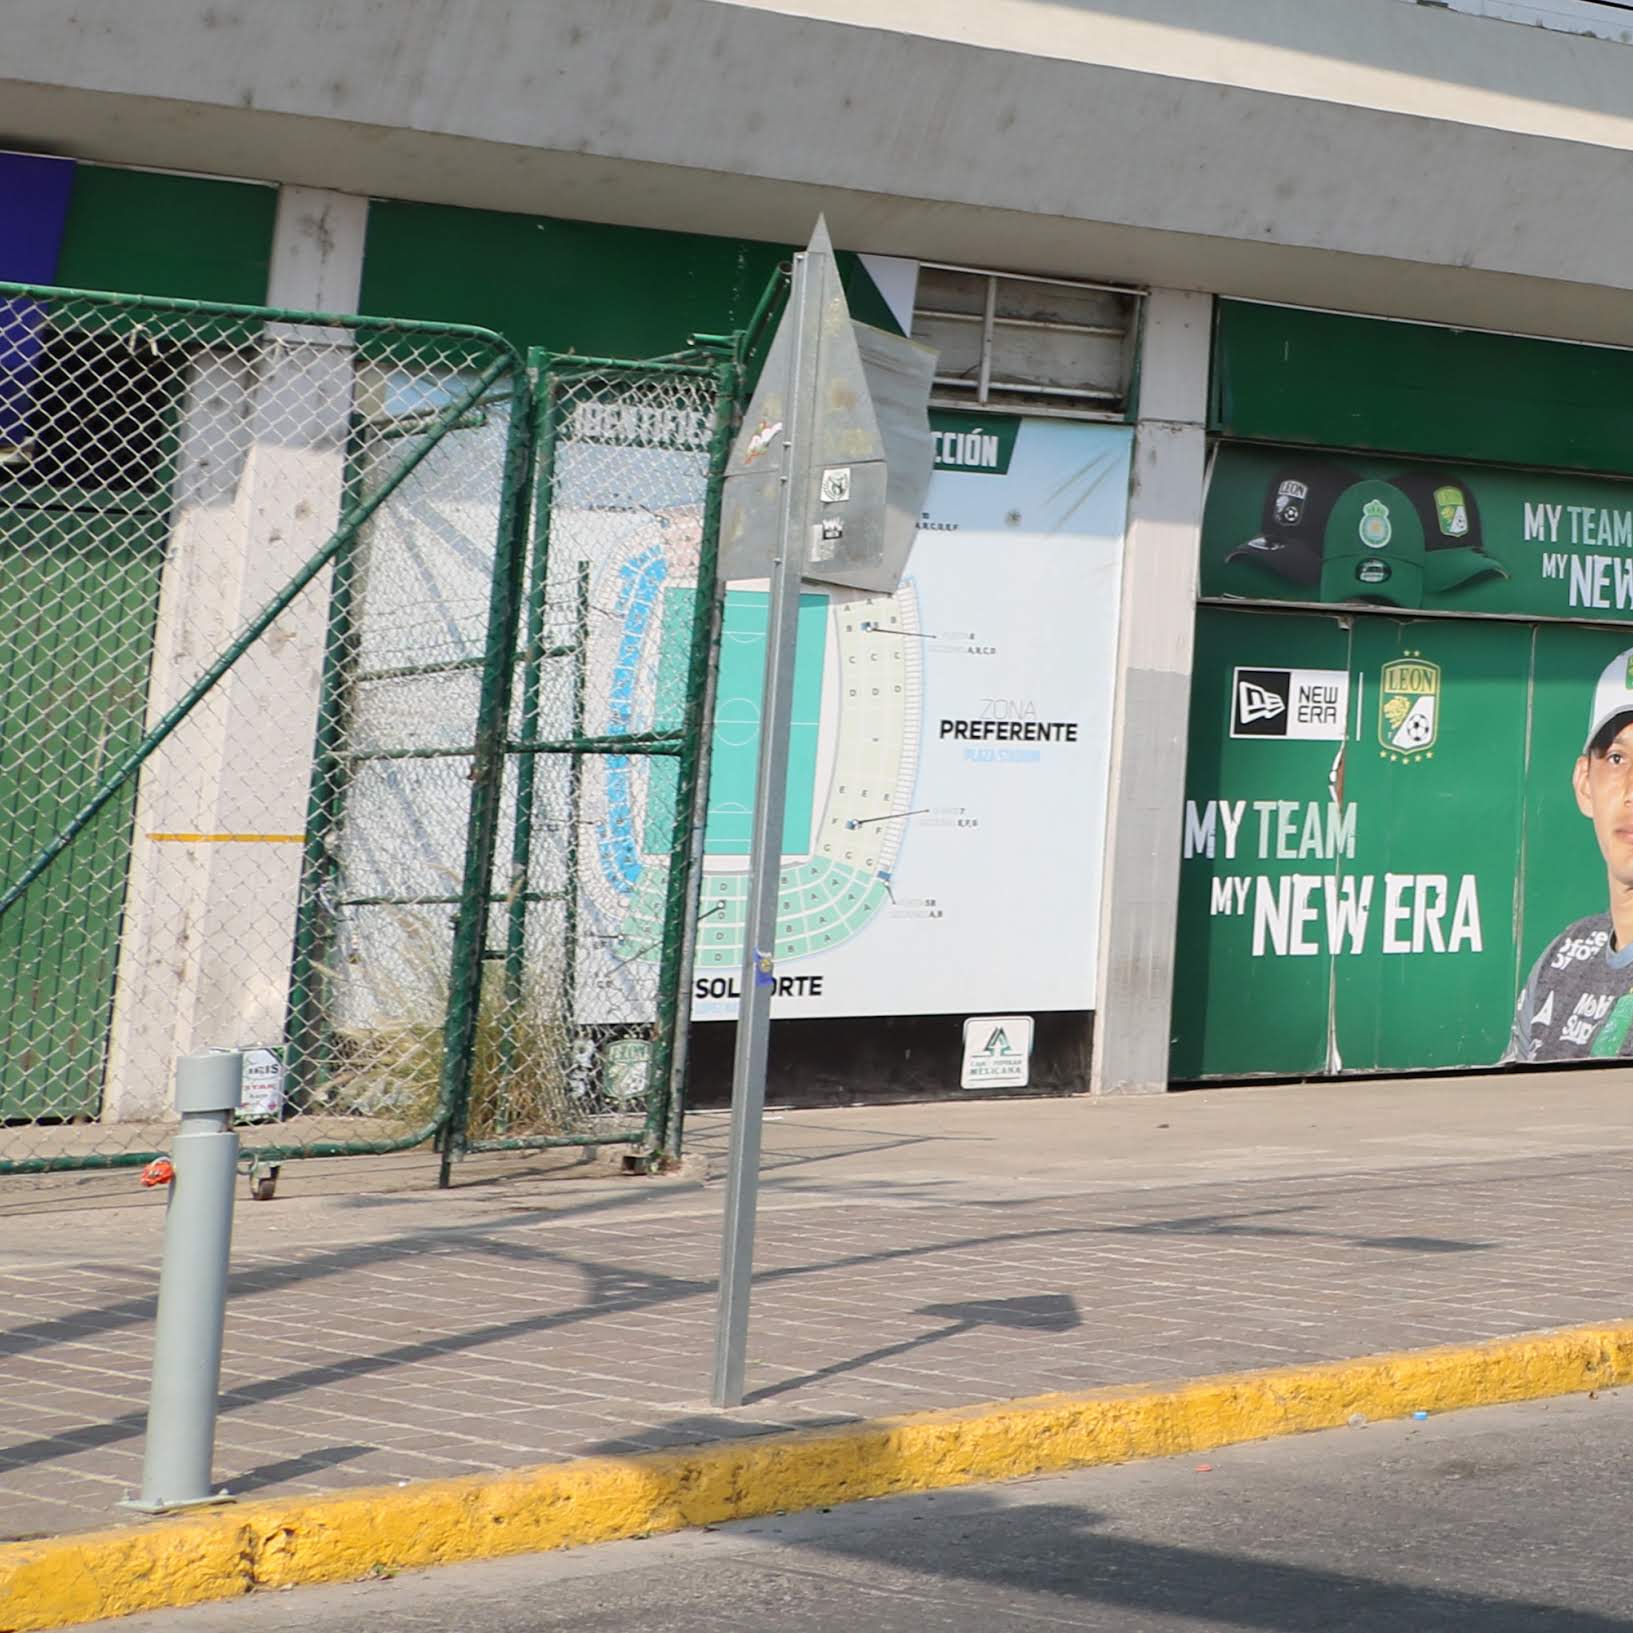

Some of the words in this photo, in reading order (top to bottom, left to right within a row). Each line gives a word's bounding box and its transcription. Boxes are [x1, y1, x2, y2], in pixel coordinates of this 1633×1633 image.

[1524, 502, 1562, 542] MY
[1567, 505, 1632, 548] TEAM
[1542, 552, 1568, 579] MY
[1387, 668, 1434, 691] LEON
[1299, 685, 1338, 704] NEW
[979, 697, 1038, 720] ZONA
[1298, 704, 1337, 724] ERA
[939, 719, 1079, 743] PREFERENTE
[1183, 800, 1246, 860] MY
[1253, 799, 1357, 860] TEAM
[1210, 875, 1251, 916] MY
[1252, 872, 1374, 957] NEW
[1383, 871, 1483, 954] ERA
[695, 977, 741, 999] SOL
